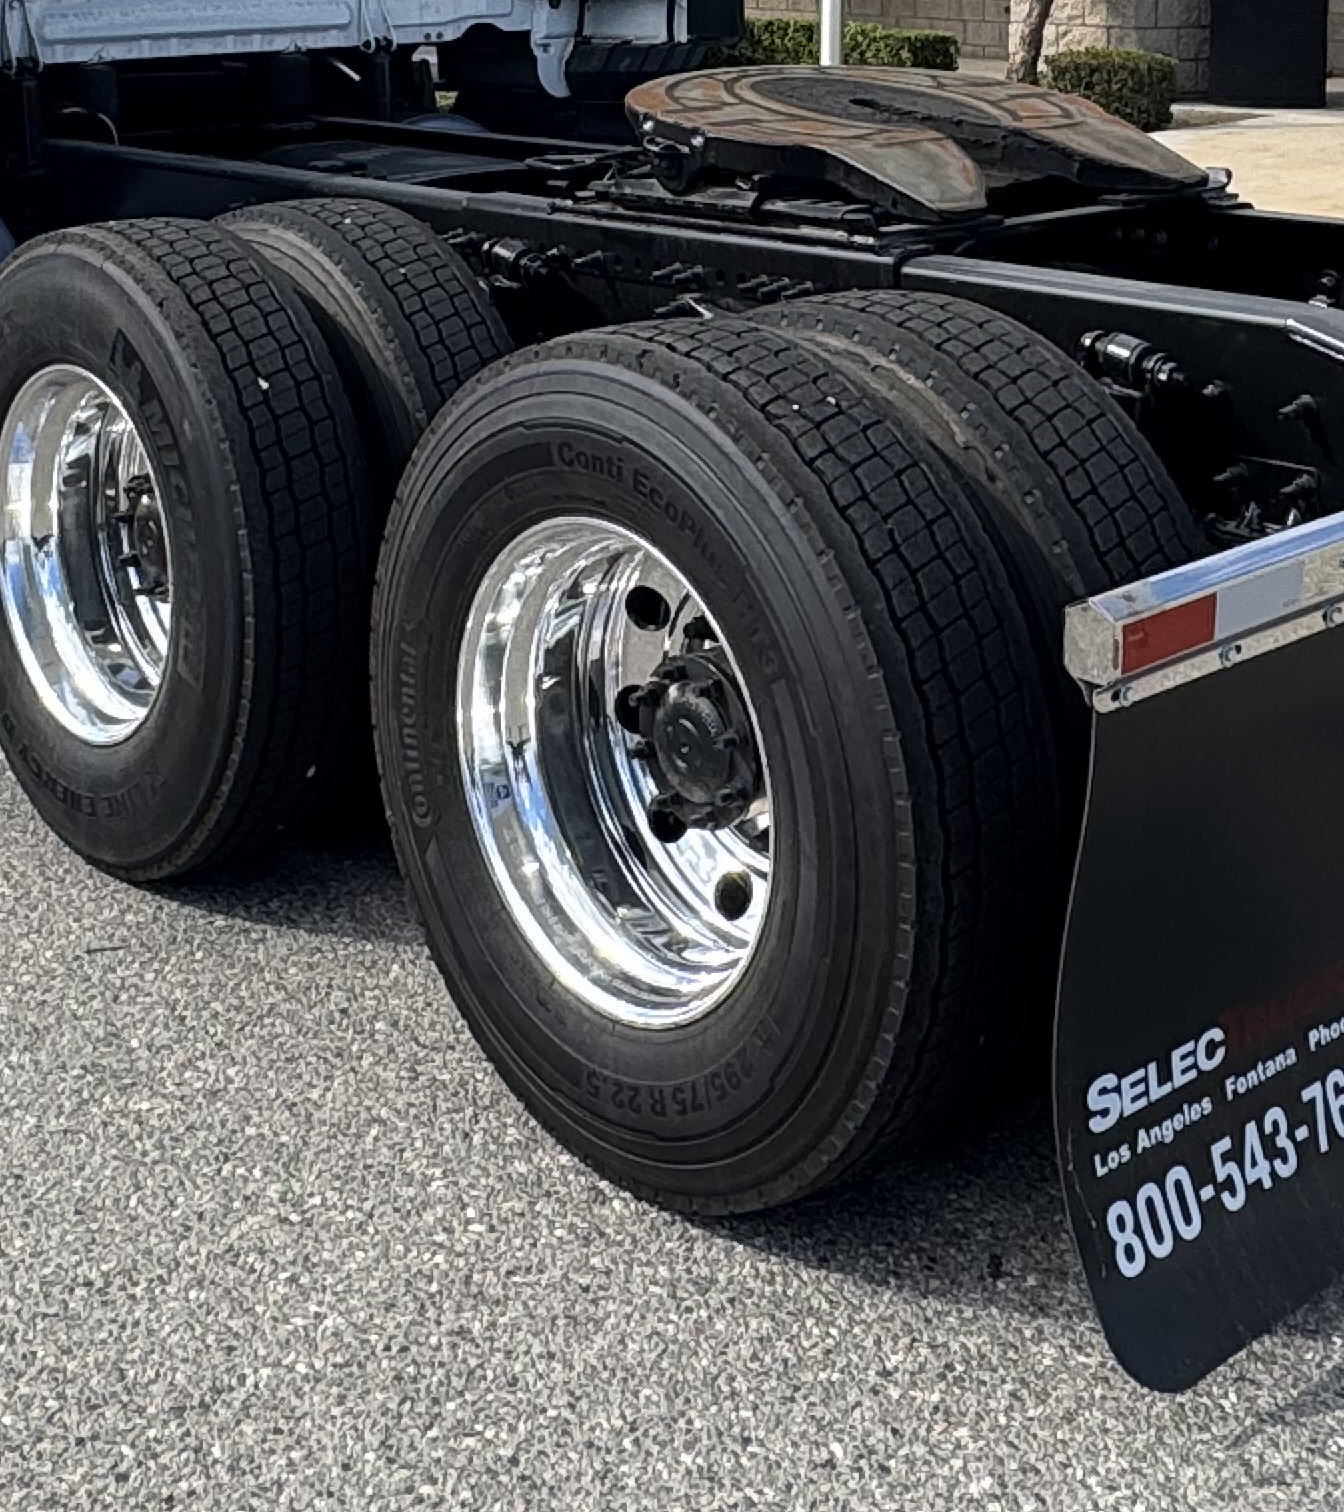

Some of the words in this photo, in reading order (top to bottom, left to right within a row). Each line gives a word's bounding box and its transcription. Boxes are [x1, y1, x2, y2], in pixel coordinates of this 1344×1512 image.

[558, 440, 625, 483] Conti
[400, 641, 432, 828] Continental
[1094, 1143, 1131, 1178] Los
[1136, 1095, 1213, 1155] Angeles
[1224, 1047, 1298, 1102] Fontana
